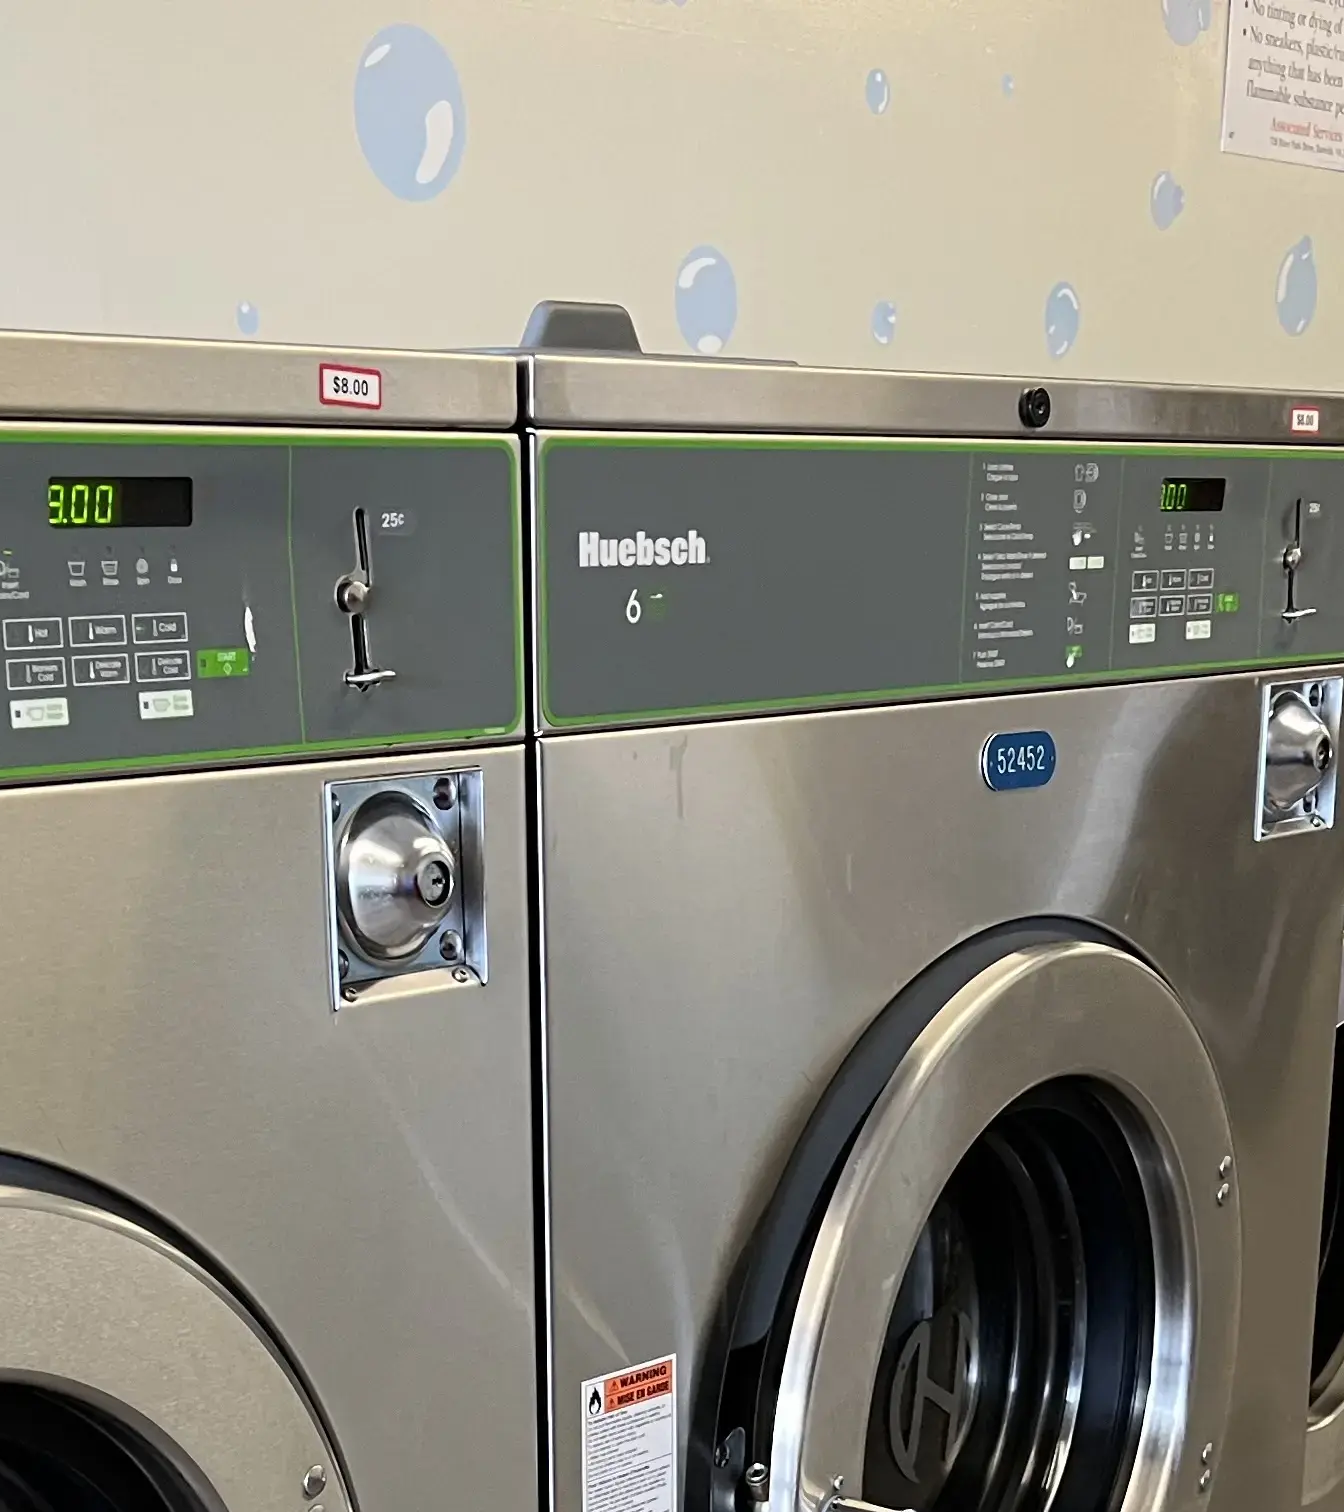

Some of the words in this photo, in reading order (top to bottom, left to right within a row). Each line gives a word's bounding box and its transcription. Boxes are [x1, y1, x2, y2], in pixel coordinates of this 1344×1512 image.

[1250, 25, 1263, 43] No
[333, 375, 369, 396] $8.00
[381, 512, 405, 528] 25¢
[579, 530, 706, 568] Huebsch
[626, 588, 642, 624] 6
[997, 744, 1046, 775] 52452
[619, 1364, 666, 1389] WARNING
